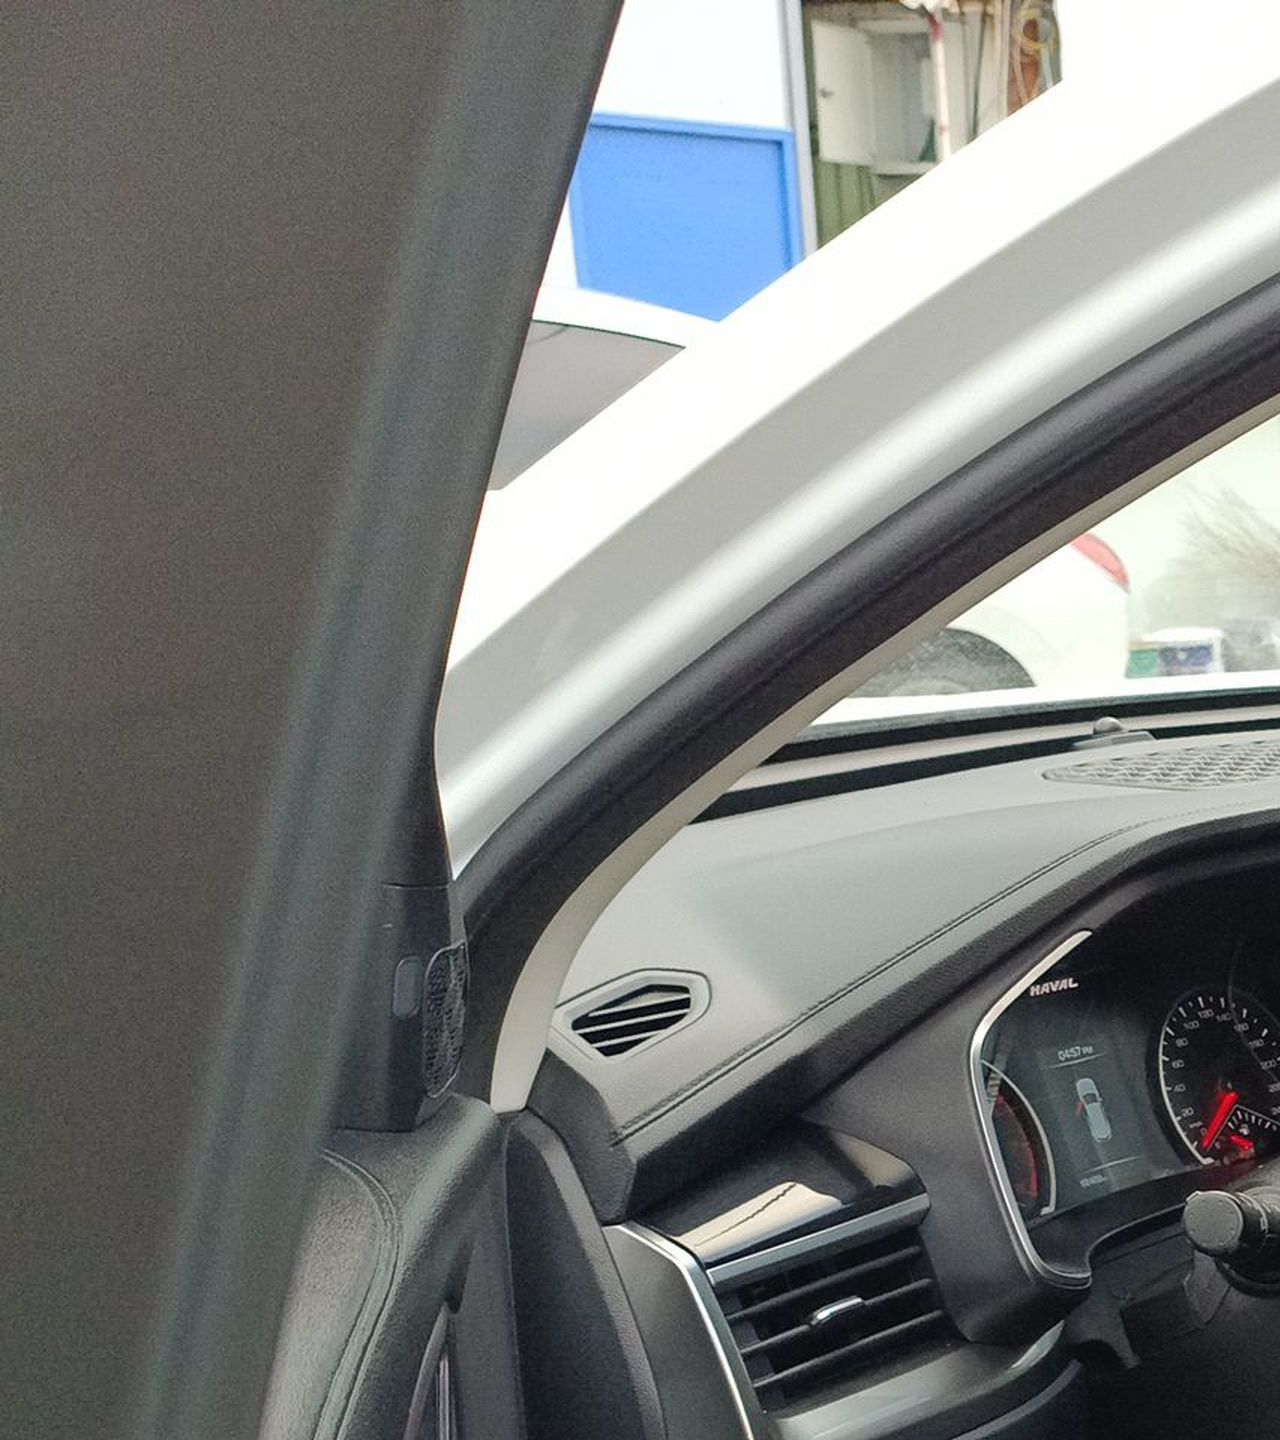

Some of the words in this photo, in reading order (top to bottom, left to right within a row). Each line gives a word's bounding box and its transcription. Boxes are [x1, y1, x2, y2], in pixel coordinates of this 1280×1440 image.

[1030, 977, 1079, 996] HAVAL
[1184, 1020, 1200, 1031] 100
[1175, 1037, 1189, 1047] 80
[1171, 1059, 1185, 1069] 60
[1173, 1083, 1186, 1093] 40
[1181, 1106, 1194, 1117] 20
